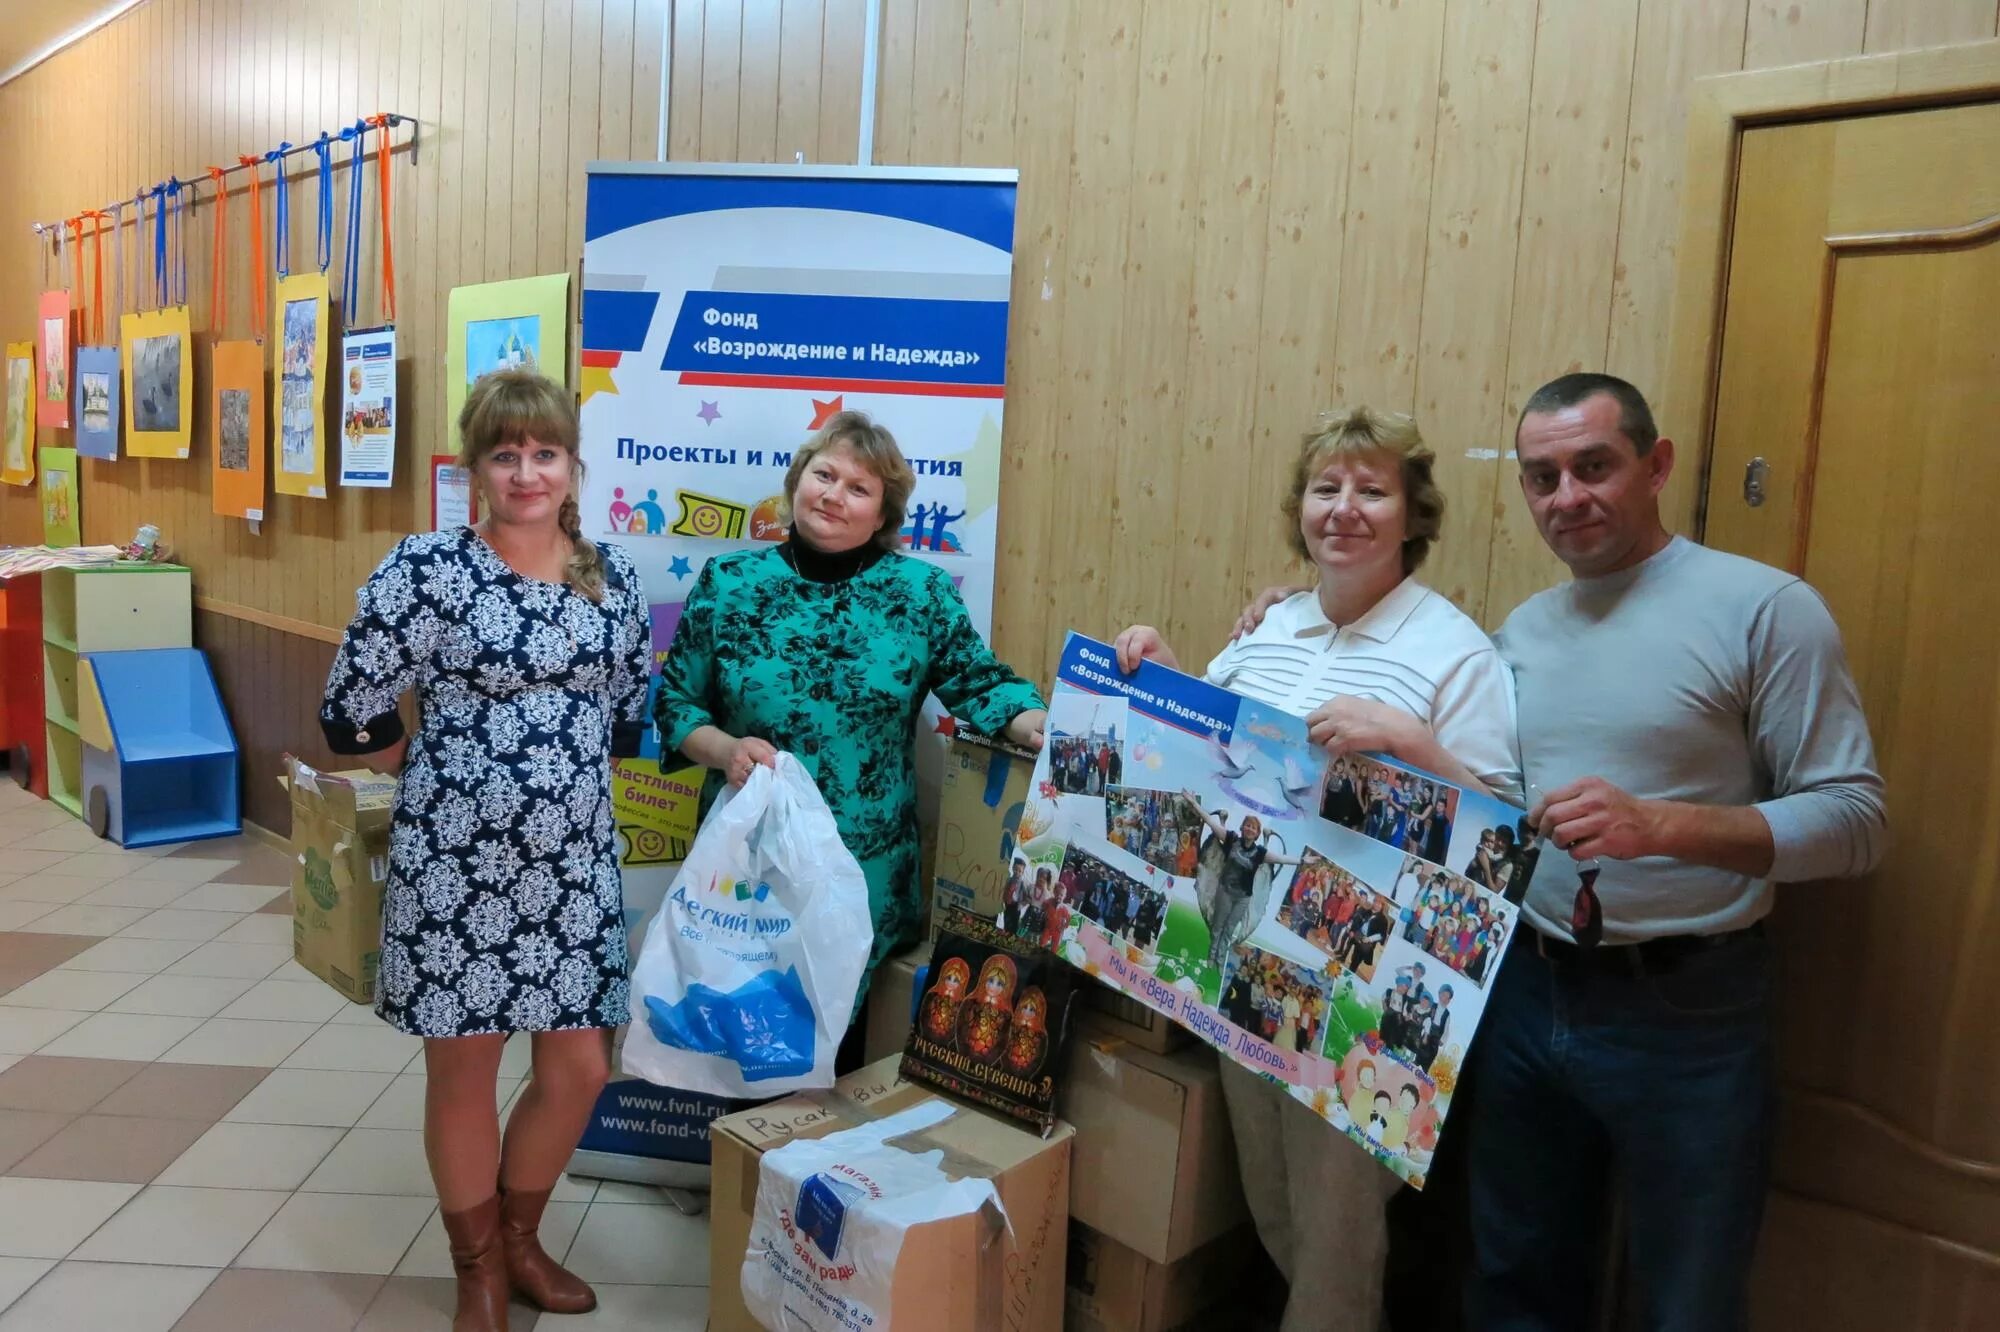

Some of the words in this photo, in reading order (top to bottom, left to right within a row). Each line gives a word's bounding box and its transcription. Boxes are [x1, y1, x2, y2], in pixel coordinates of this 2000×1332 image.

[703, 307, 758, 329] Фонд
[693, 336, 847, 360] «Возрождение
[853, 347, 865, 361] и
[871, 343, 981, 367] Надежда»
[616, 438, 736, 465] Проекты
[747, 450, 763, 466] и
[1079, 647, 1111, 669] Фонд
[1070, 662, 1155, 703] «Возрождение
[1156, 696, 1164, 707] и
[1166, 698, 1232, 733] Надежда»
[612, 802, 649, 819] рофессия
[624, 786, 678, 811] билет
[754, 917, 791, 938] мир
[1109, 955, 1126, 976] Мы
[1129, 971, 1137, 984] и
[1140, 978, 1177, 1012] «Вера.
[1180, 998, 1232, 1047] Надежда.
[1234, 1033, 1298, 1072] Любовь.»
[617, 1094, 727, 1119] www.fvnl.ru
[746, 1107, 832, 1138] Русак
[794, 1242, 817, 1273] вам
[819, 1261, 858, 1281] рады
